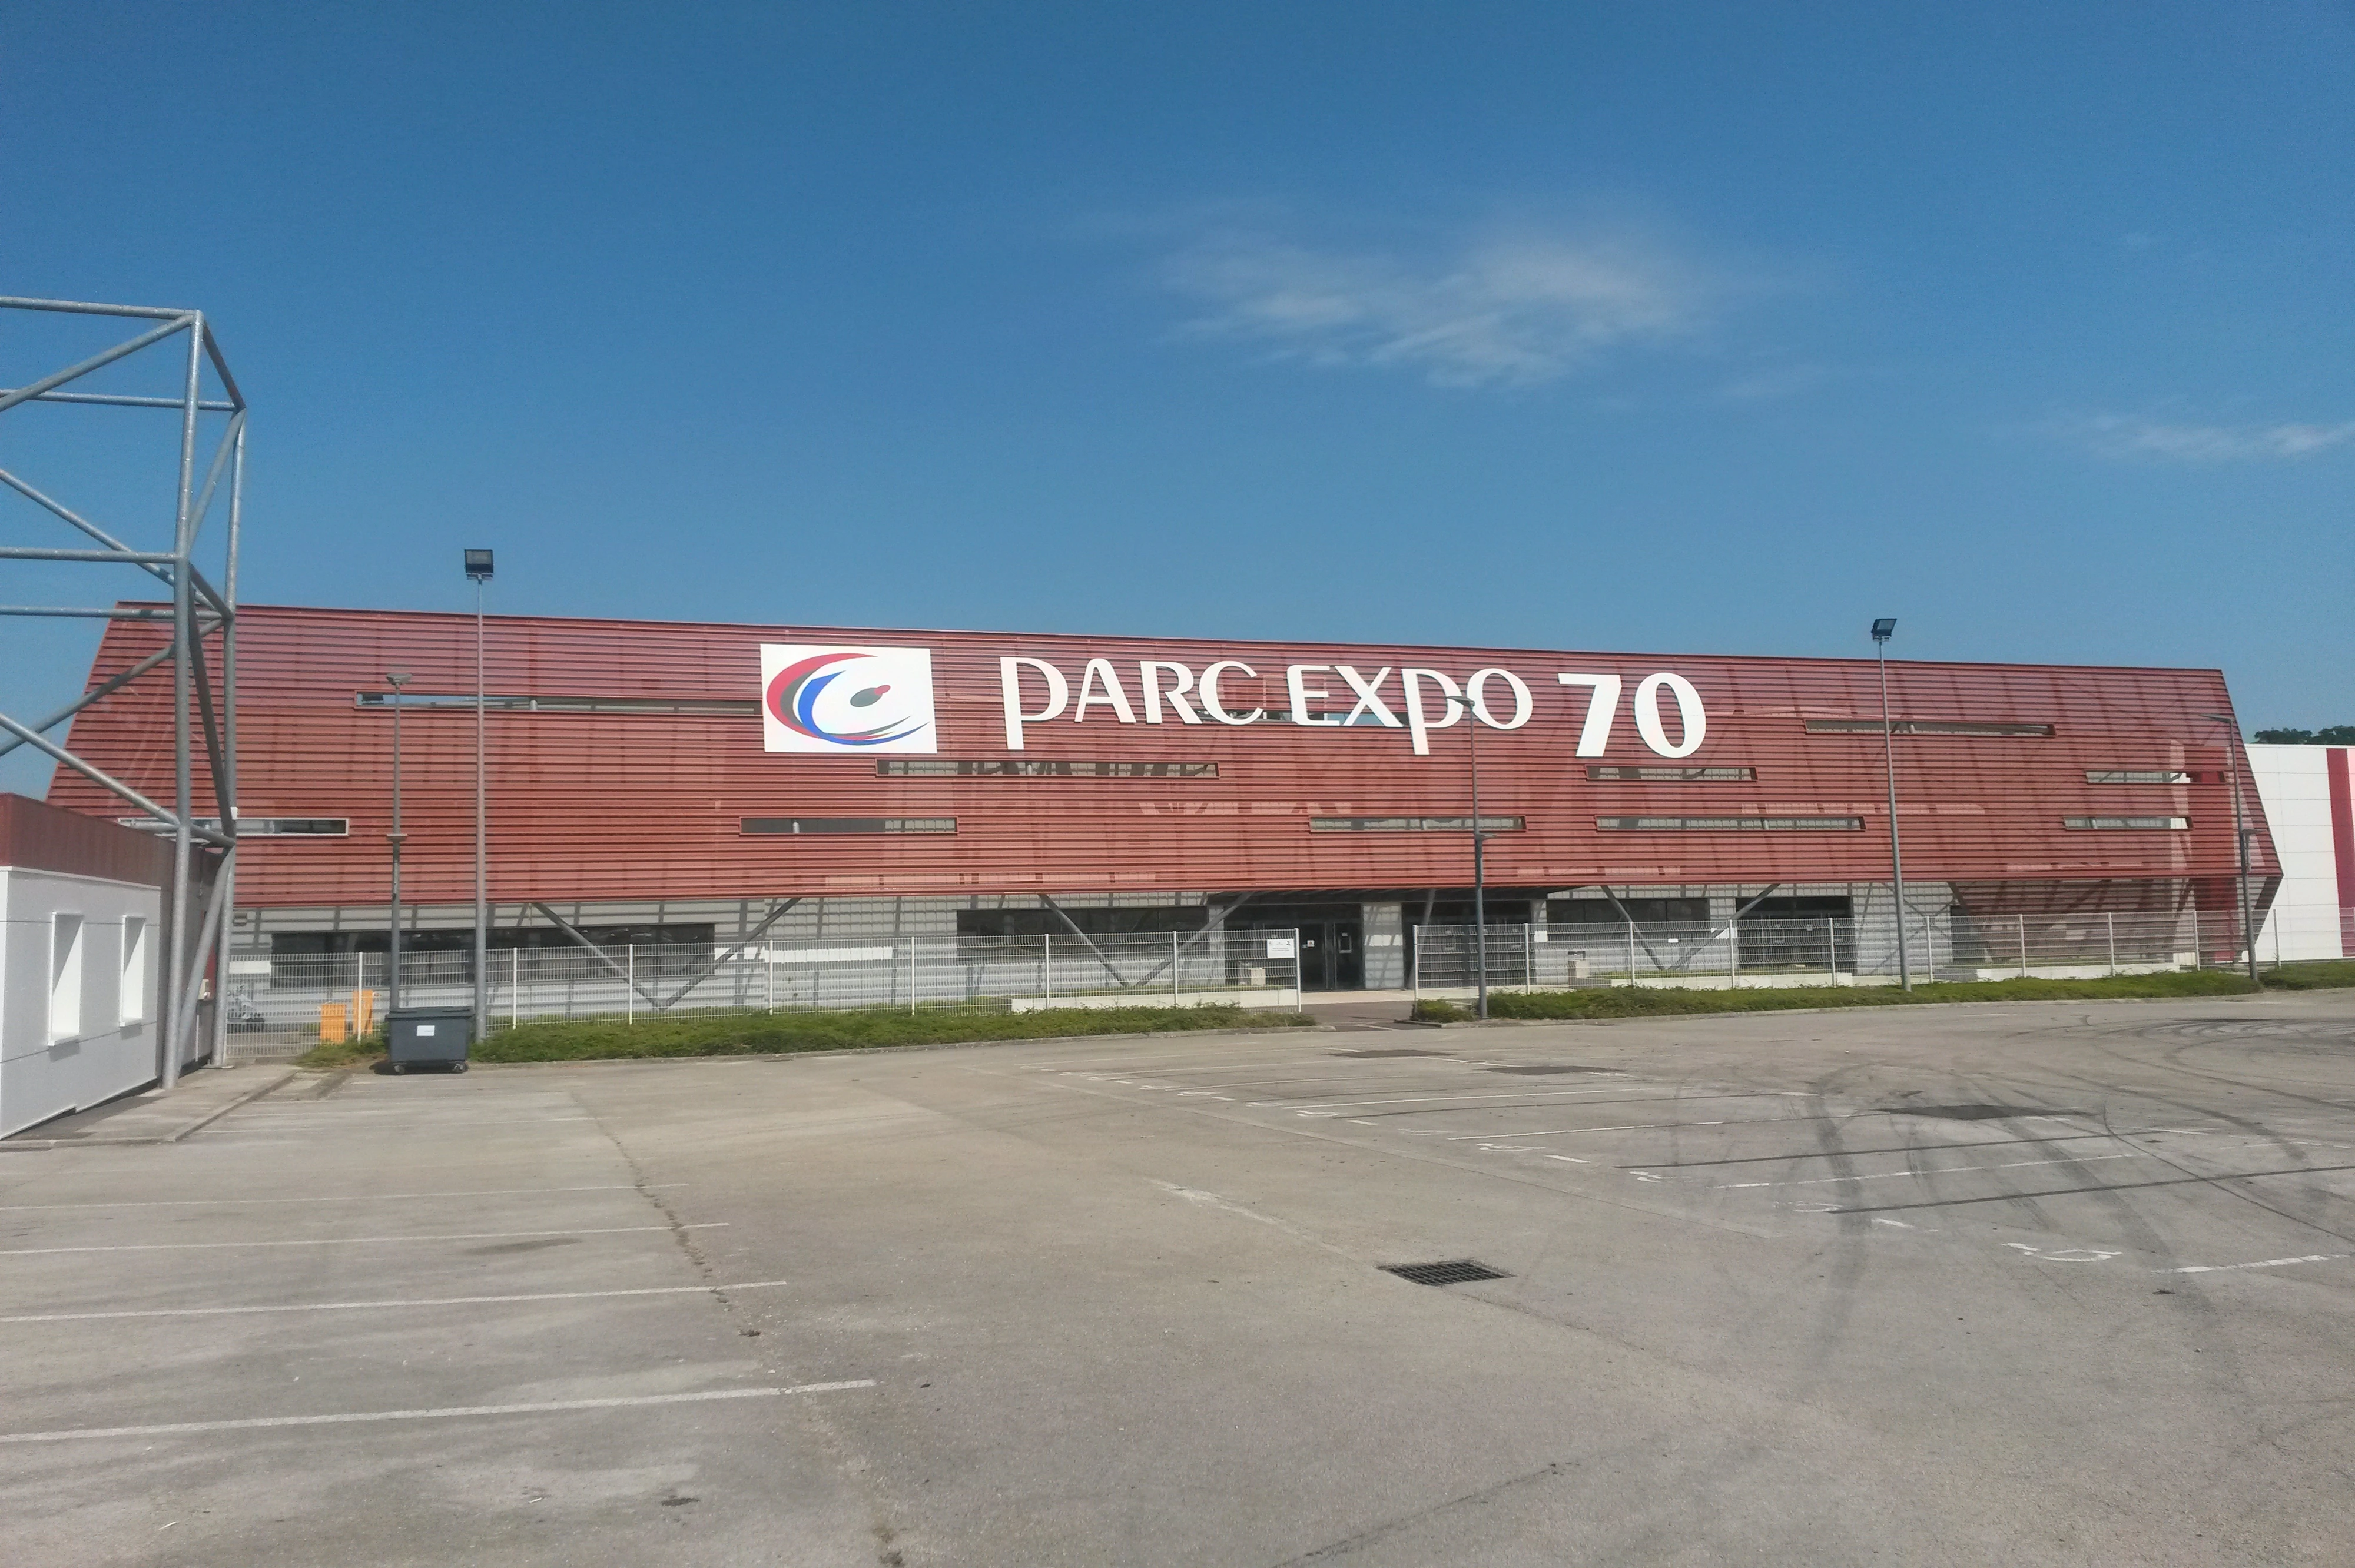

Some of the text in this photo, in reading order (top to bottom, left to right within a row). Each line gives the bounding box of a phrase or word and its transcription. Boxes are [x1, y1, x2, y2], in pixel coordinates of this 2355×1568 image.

[999, 656, 1707, 758] PARC EXPO 70
